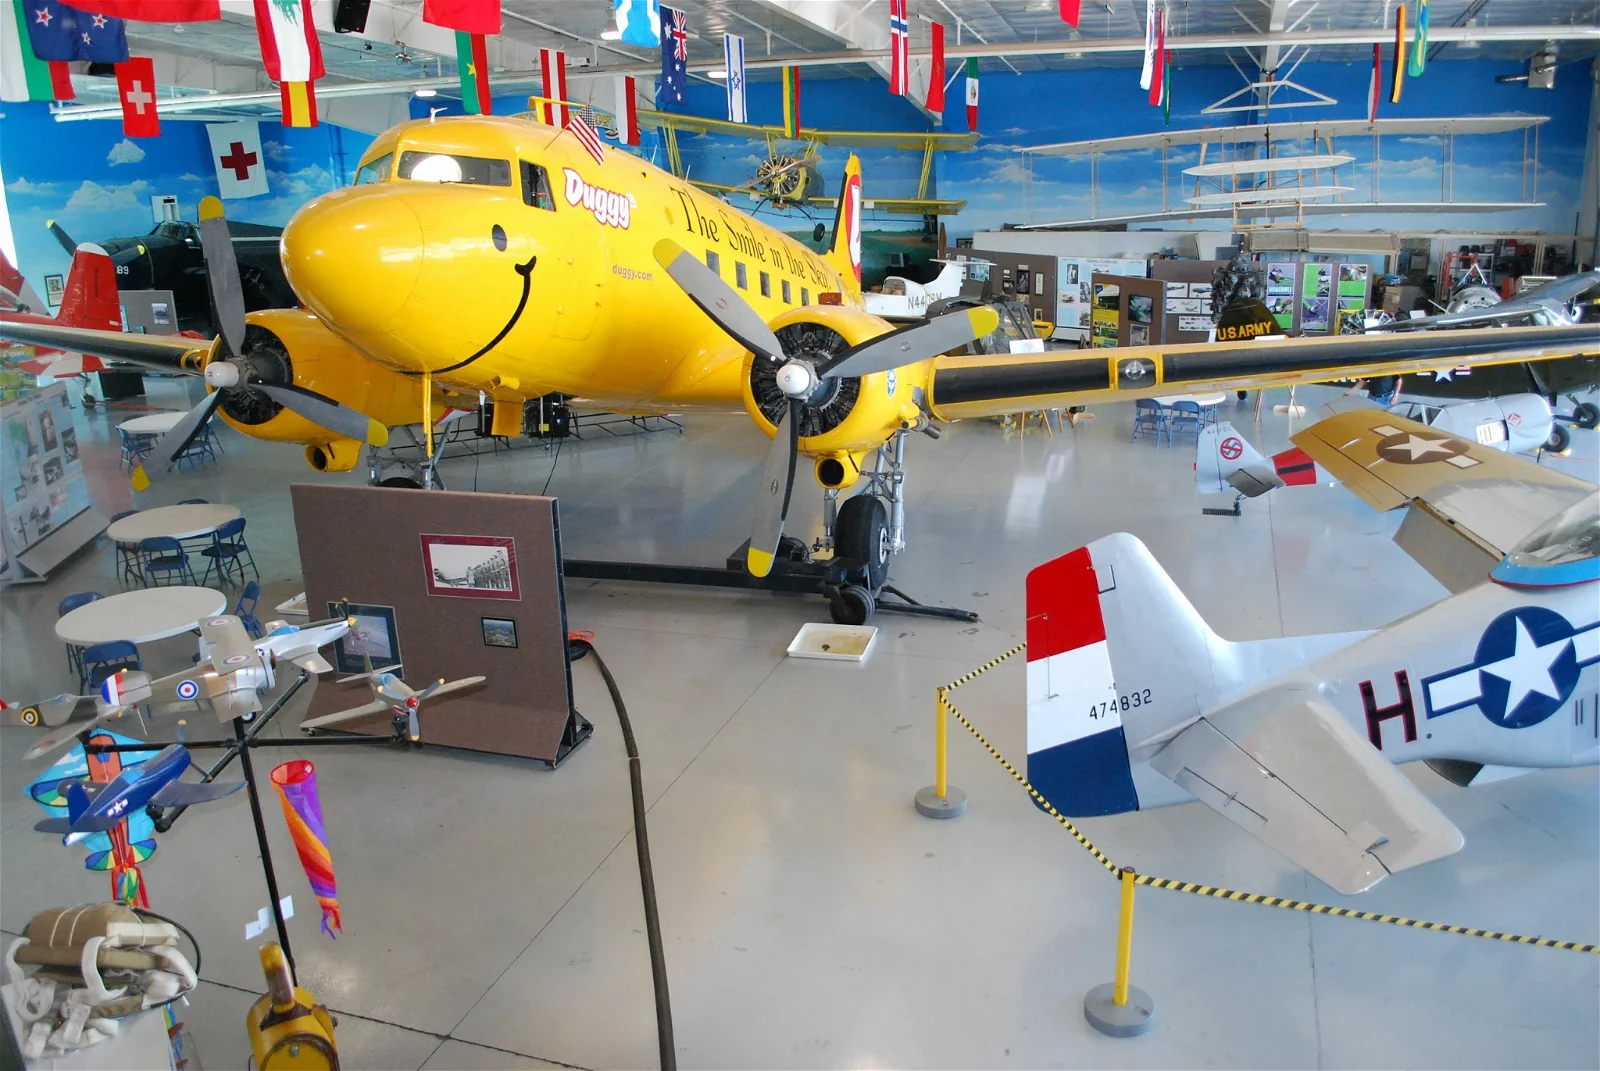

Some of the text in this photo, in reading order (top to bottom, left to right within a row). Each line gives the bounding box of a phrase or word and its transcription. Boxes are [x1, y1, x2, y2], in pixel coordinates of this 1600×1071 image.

[562, 167, 631, 230] Duggy
[668, 185, 720, 243] The
[718, 209, 767, 263] Smile
[764, 235, 785, 270] in
[780, 237, 806, 279] the
[116, 265, 129, 275] 89
[612, 262, 653, 281] duggy.com
[1088, 688, 1152, 720] 474832
[1359, 669, 1418, 751] H
